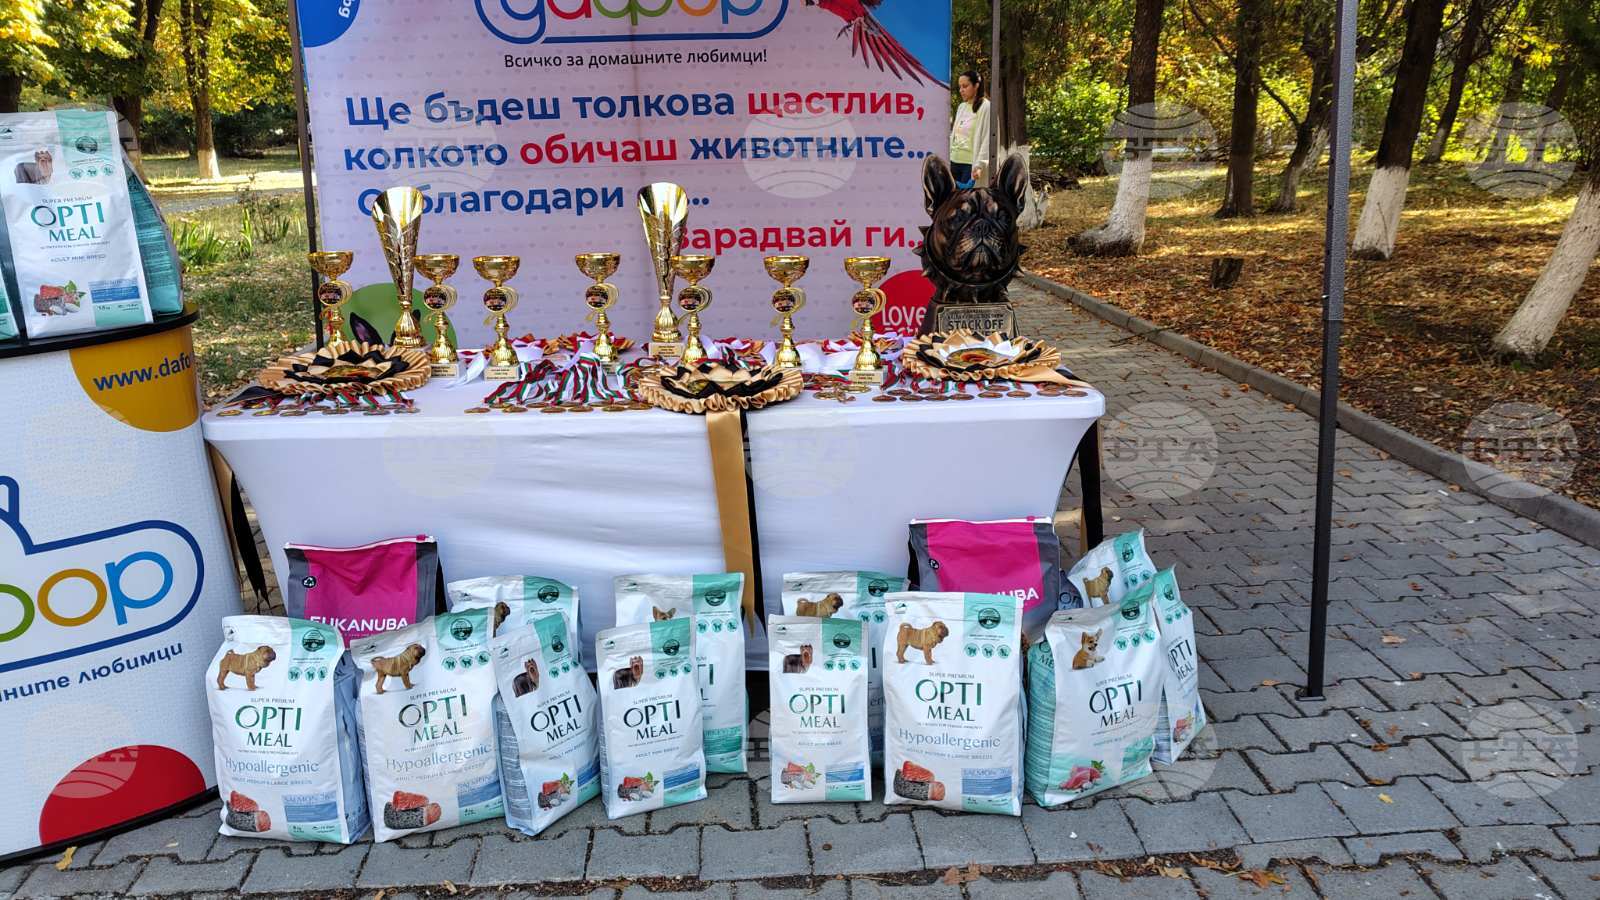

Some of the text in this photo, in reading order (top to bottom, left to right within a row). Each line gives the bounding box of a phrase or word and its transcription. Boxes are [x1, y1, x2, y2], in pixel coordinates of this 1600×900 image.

[505, 49, 767, 68] Всичко за домашните любимци!
[346, 91, 925, 130] Ще бъдеш толкова щастлив,
[344, 143, 508, 171] колкото
[520, 133, 677, 165] обичаш
[689, 135, 933, 160] животните...
[30, 201, 105, 227] OPTI
[49, 226, 101, 242] MEAL
[948, 319, 1004, 330] STACK OFF
[0, 643, 183, 702] ните любимци
[788, 694, 845, 715] OPTI
[915, 679, 982, 706] OPTI
[1089, 679, 1142, 714] OPTI
[235, 705, 302, 731] OPTI
[398, 694, 468, 728] OPTI
[531, 694, 582, 732] OPTI
[623, 699, 681, 728] OPTI
[799, 715, 841, 729] MEAL
[927, 705, 975, 721] MEAL
[1100, 707, 1137, 728] MEAL
[246, 732, 293, 748] MEAL
[413, 721, 464, 744] MEAL
[547, 718, 582, 743] MEAL
[635, 722, 677, 741] MEAL
[899, 728, 1001, 751] Hypoallergenic
[225, 757, 320, 778] Hypoallergenic
[386, 743, 493, 773] Hypoallergenic
